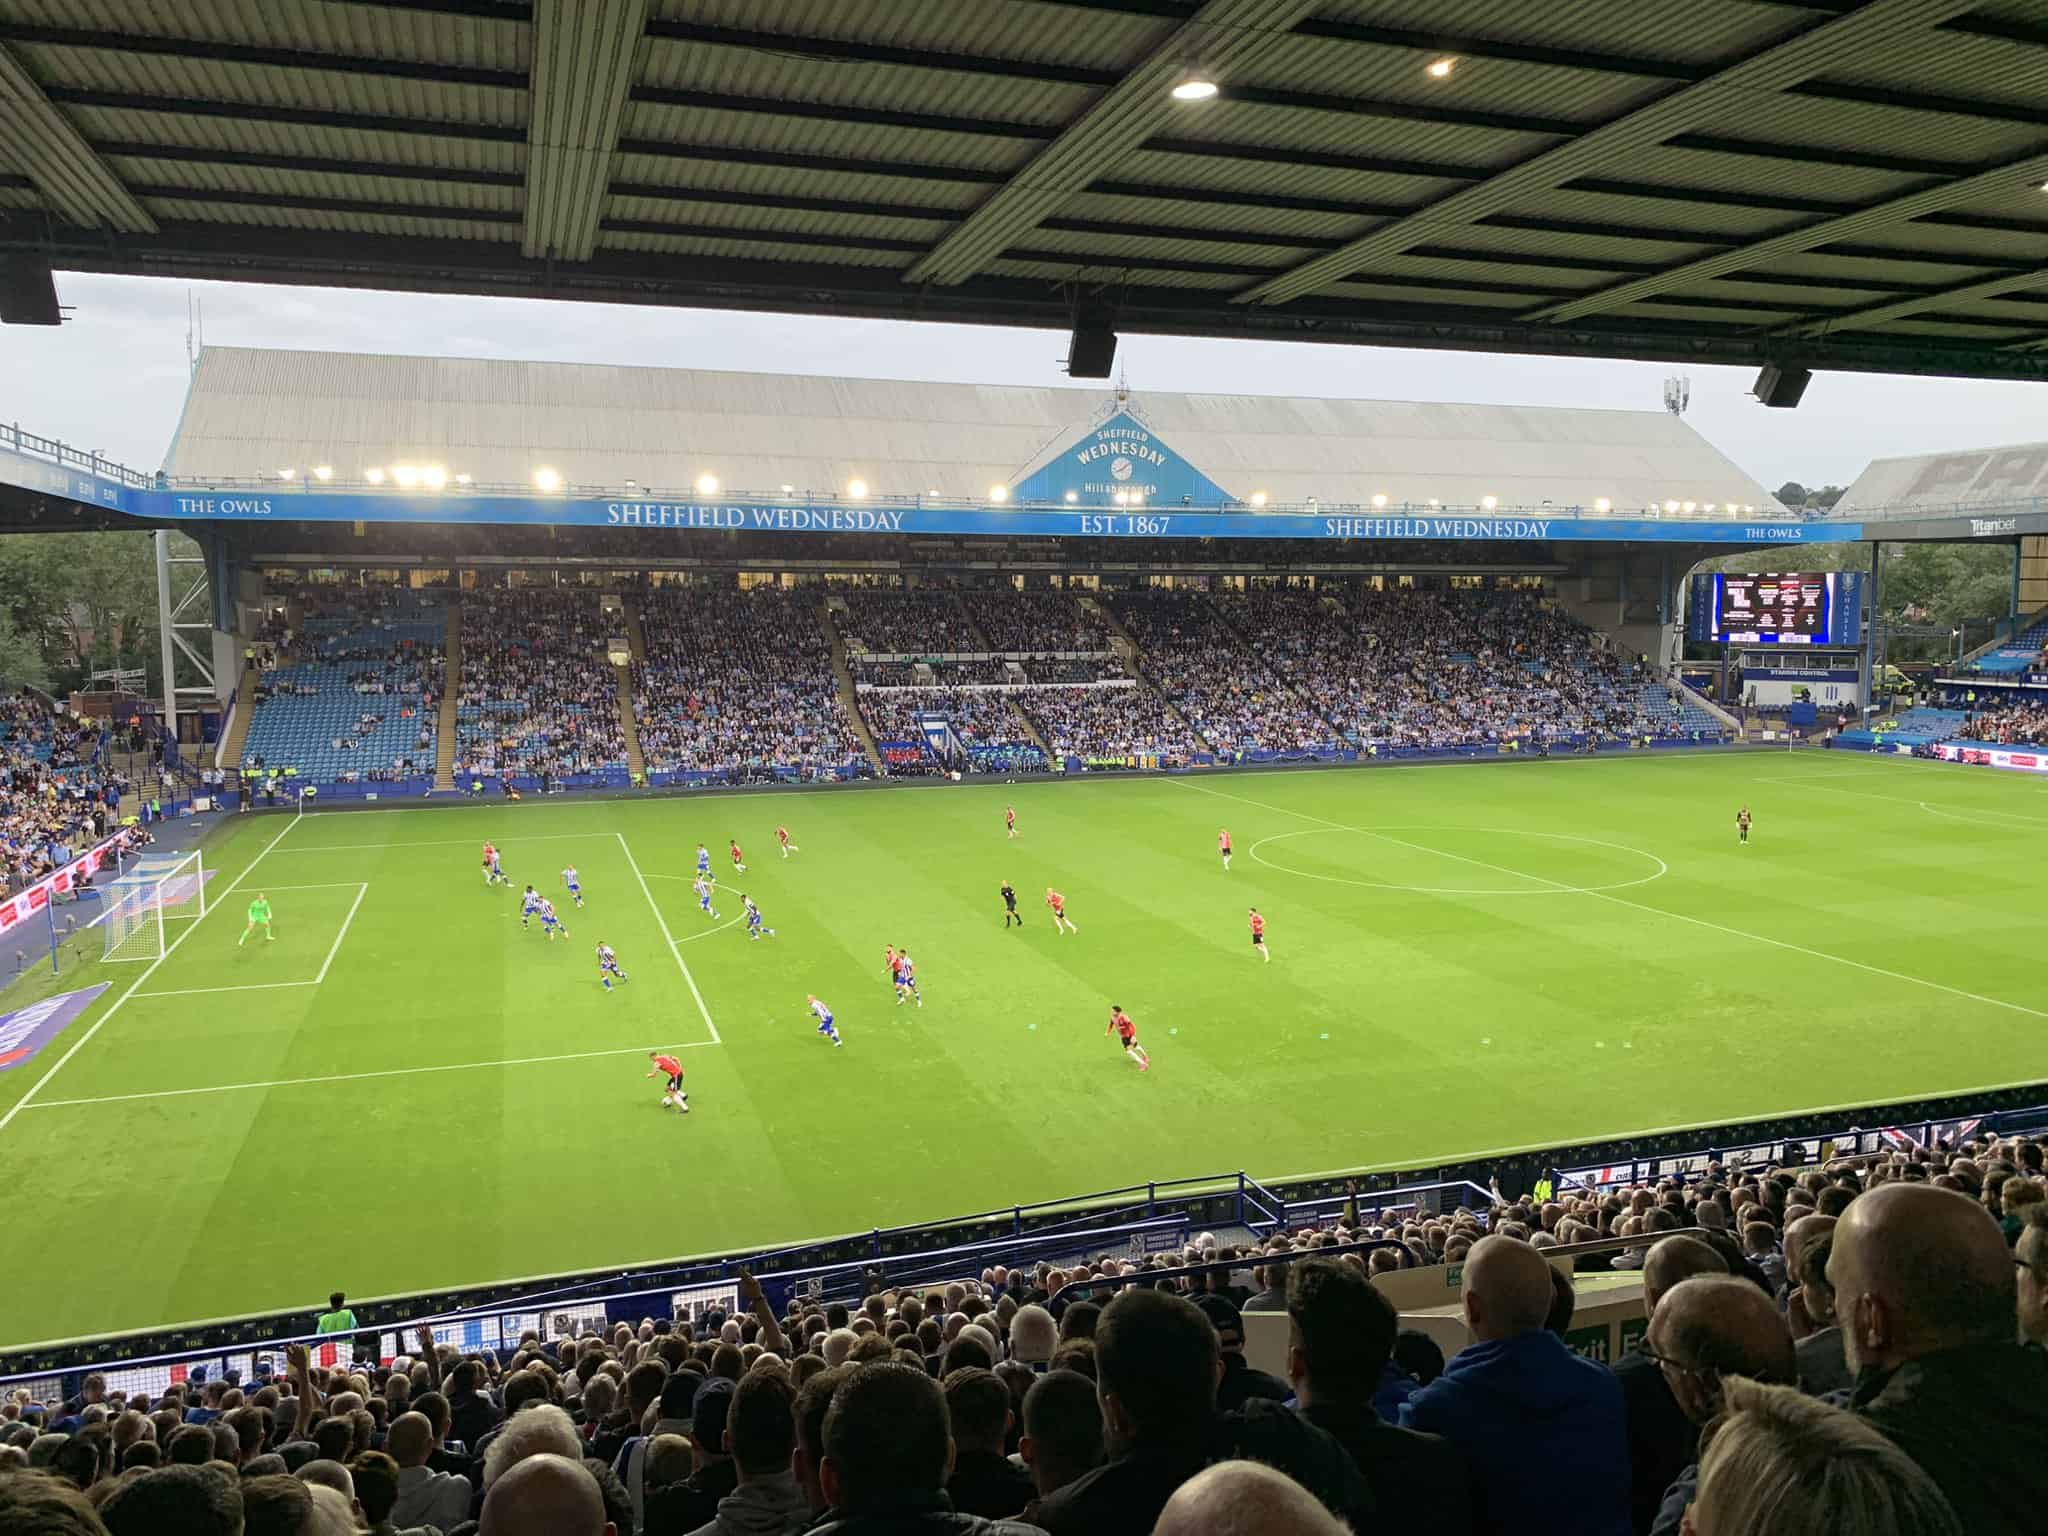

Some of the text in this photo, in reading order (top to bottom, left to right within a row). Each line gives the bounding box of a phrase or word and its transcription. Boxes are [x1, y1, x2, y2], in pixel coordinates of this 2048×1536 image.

[1097, 429, 1148, 442] SHEFFIELD
[1077, 442, 1166, 467] WEDNESDAY
[178, 498, 272, 514] THE OWLS
[607, 503, 904, 530] SHEFFIELD WEDNESDAY
[1080, 515, 1171, 534] EST. 1867
[1326, 518, 1551, 538] SHEFFIELD WEDNESDAY
[1744, 528, 1801, 538] THE OWLS
